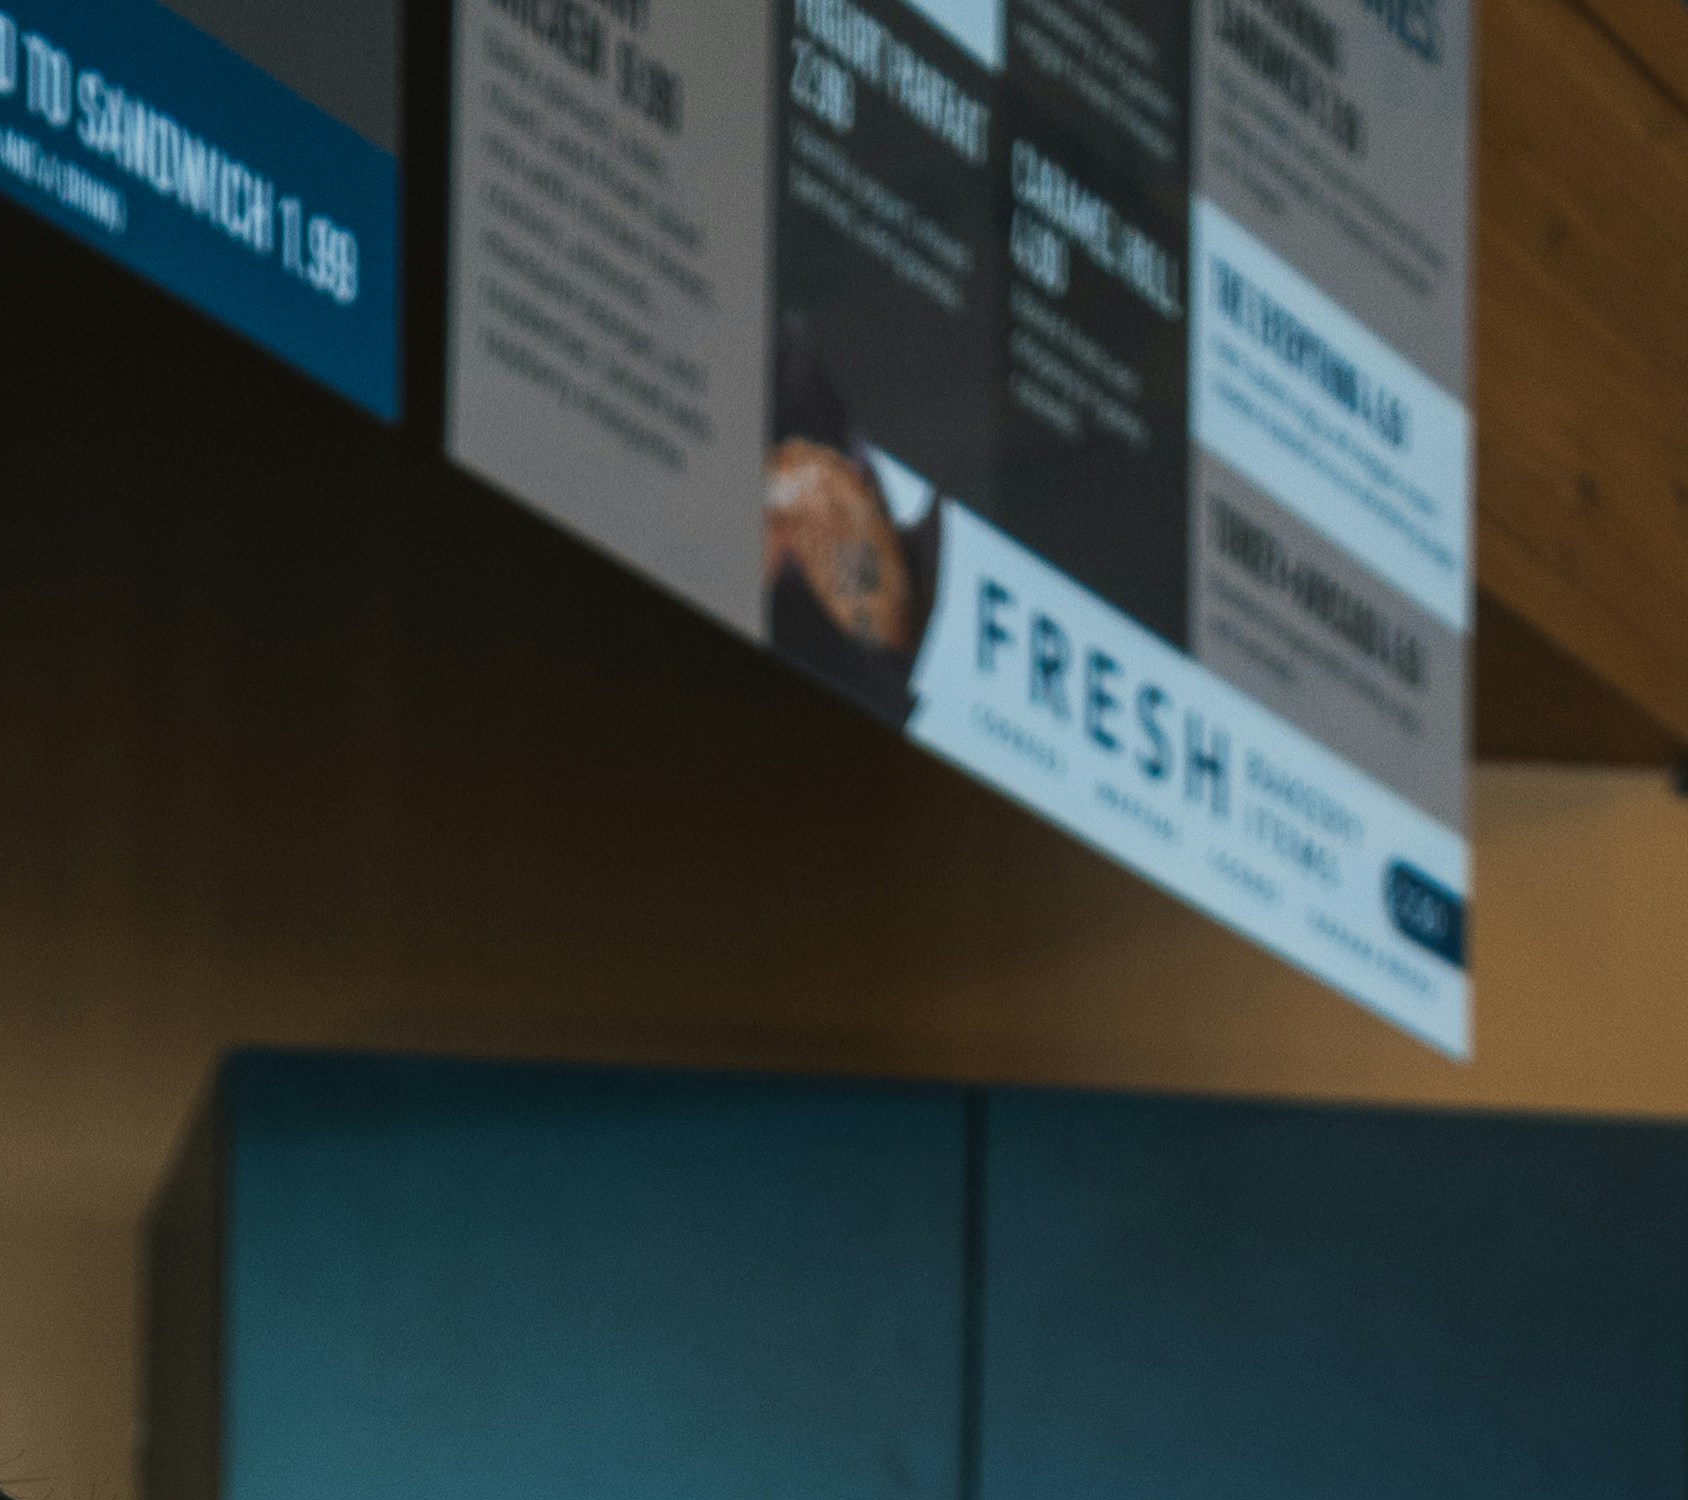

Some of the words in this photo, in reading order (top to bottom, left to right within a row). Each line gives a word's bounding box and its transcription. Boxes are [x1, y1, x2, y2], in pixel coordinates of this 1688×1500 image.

[22, 31, 72, 128] TO
[77, 70, 276, 253] SANDWICH
[975, 577, 1231, 820] FRESH
